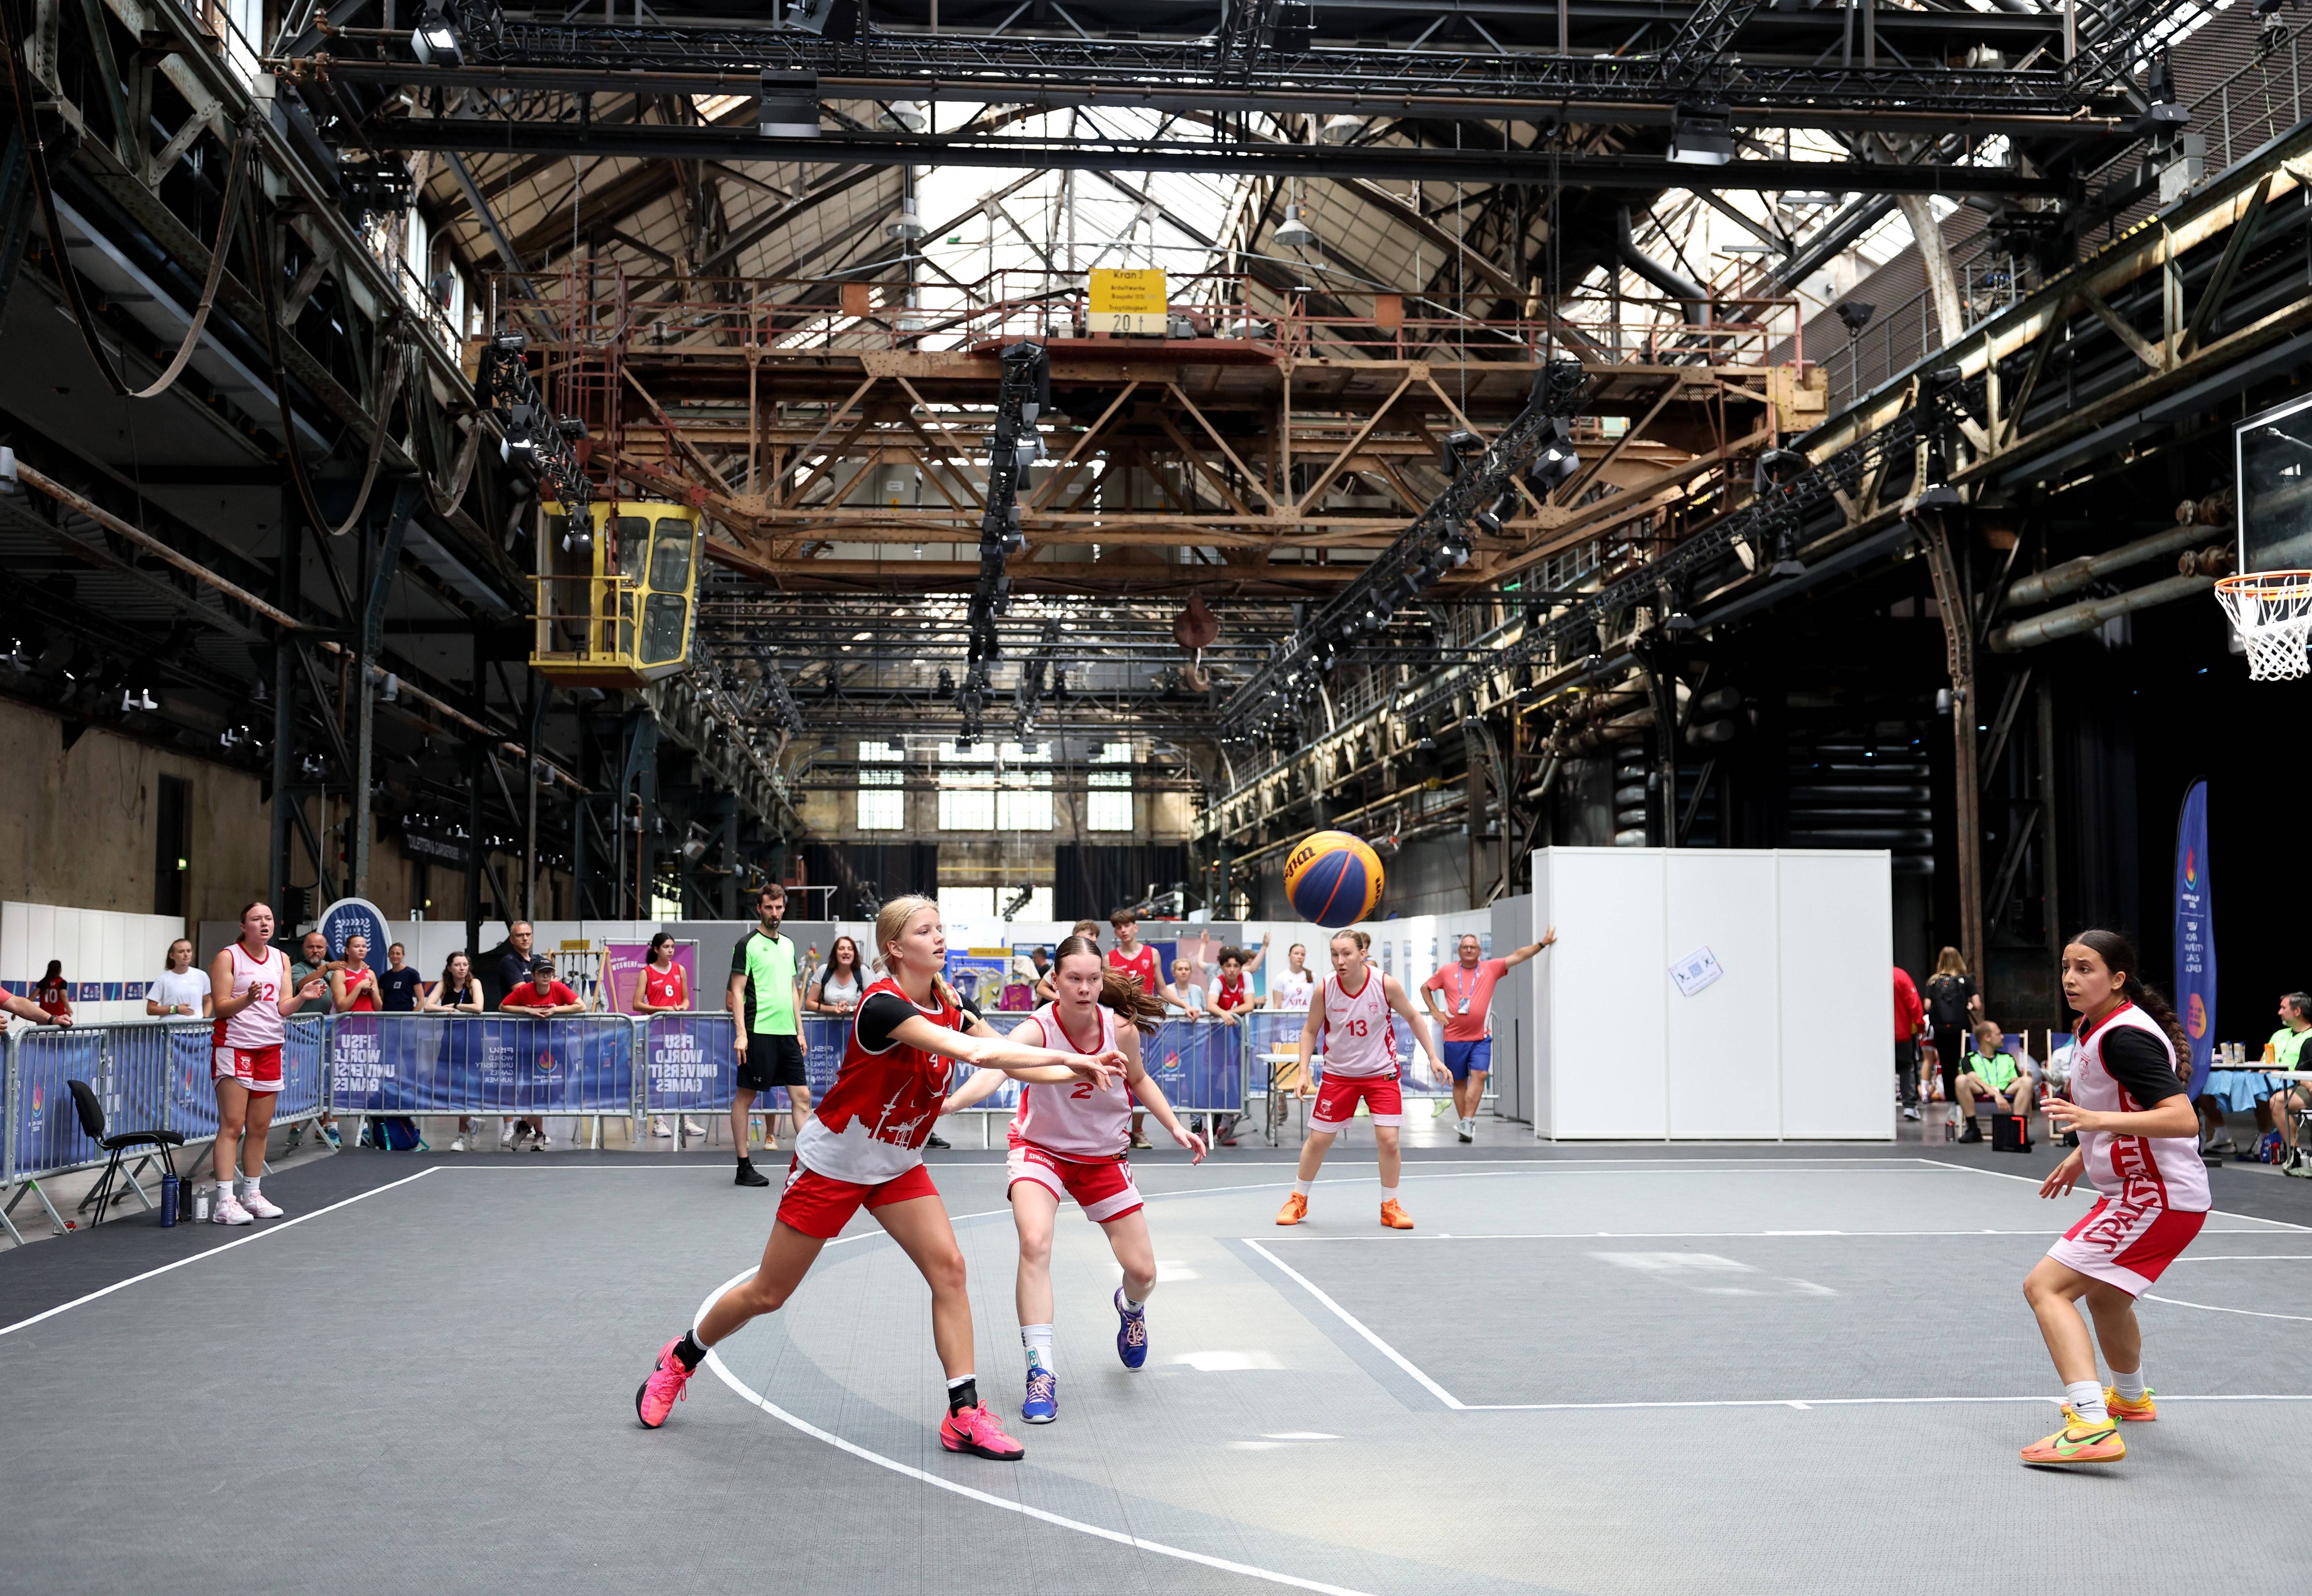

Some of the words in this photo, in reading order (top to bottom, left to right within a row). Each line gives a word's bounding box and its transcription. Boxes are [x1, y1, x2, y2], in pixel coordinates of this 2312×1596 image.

[1114, 270, 1137, 279] Kran
[1114, 314, 1131, 331] 20
[1139, 315, 1143, 331] t
[1128, 970, 1137, 979] 7
[665, 984, 674, 997] 6
[1346, 1020, 1368, 1037] 13
[928, 1053, 939, 1068] 4
[1070, 1082, 1094, 1099] 2
[2011, 1116, 2024, 1145] 7
[1028, 1153, 1055, 1169] SPALDING
